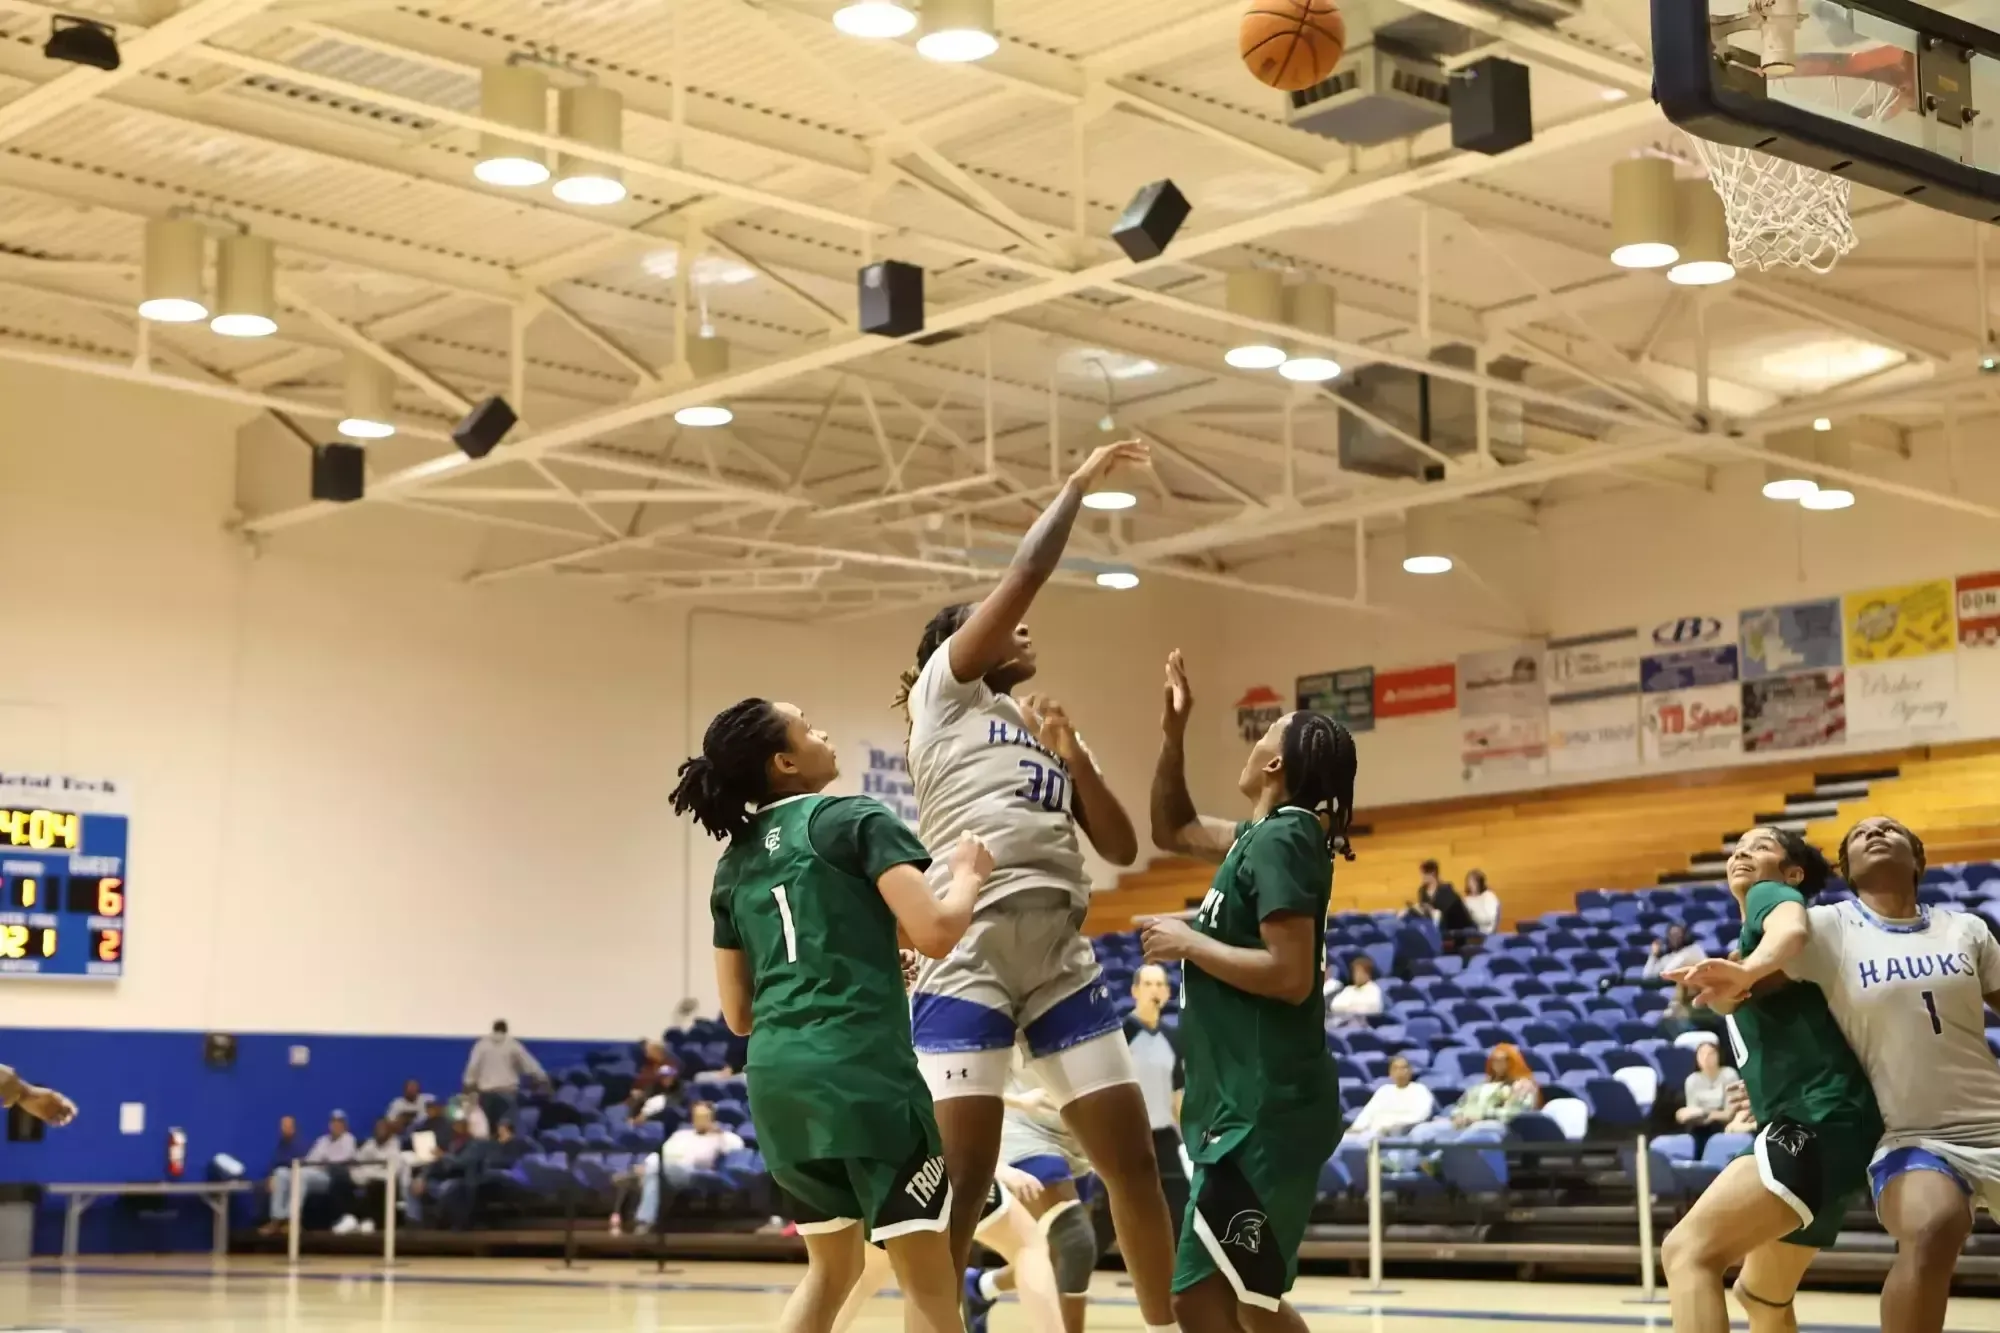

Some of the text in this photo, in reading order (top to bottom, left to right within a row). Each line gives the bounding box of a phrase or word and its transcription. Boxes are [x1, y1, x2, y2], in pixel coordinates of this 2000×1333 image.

[1015, 759, 1065, 812] 30
[22, 879, 35, 908] 1
[98, 877, 123, 917] 6
[771, 884, 797, 964] 1
[99, 929, 121, 962] 2
[1859, 952, 1975, 988] HAWKS
[1921, 990, 1942, 1035] 1
